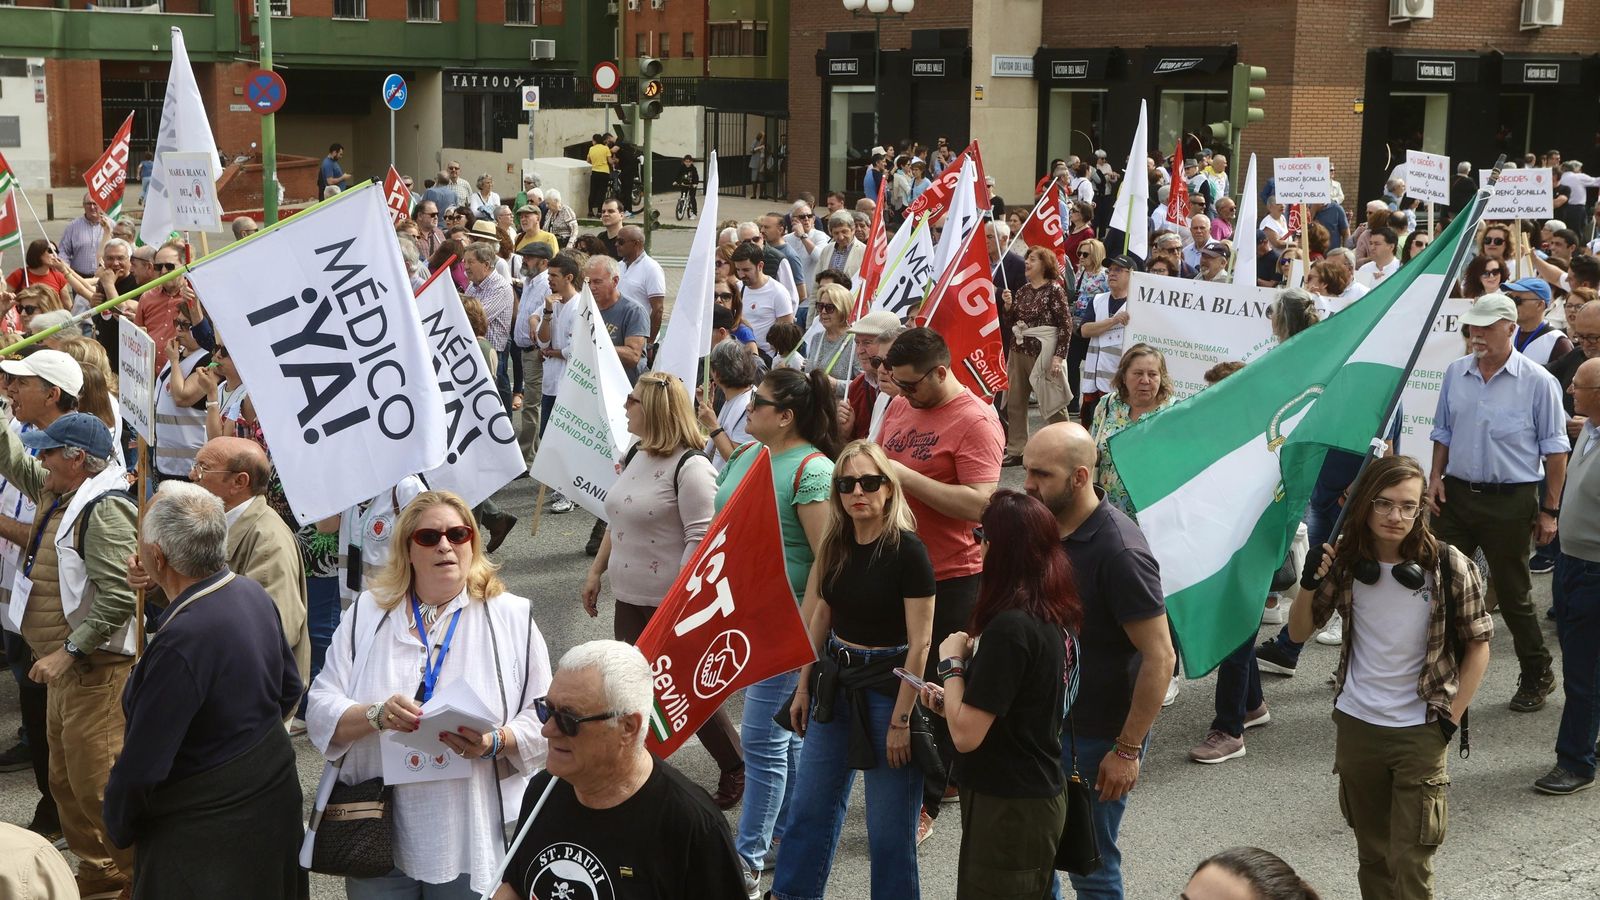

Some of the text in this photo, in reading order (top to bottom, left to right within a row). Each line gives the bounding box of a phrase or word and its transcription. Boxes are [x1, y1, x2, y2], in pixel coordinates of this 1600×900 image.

[452, 75, 510, 88] TATTOO
[168, 168, 207, 177] MAREA BLANCA
[1138, 286, 1209, 312] MAREA
[315, 237, 416, 441] MÉDICO
[1132, 333, 1229, 355] POR UNA ATENCIÓN PRIMARIA
[246, 287, 371, 445] ¡YA!
[573, 358, 591, 377] UNA
[1180, 350, 1190, 358] DE
[1190, 351, 1218, 363] CALIDAD
[422, 308, 517, 445] MÉDICO
[1407, 380, 1440, 391] FIENDE
[554, 417, 593, 447] SANIDAD
[650, 654, 690, 733] Sevilla
[539, 846, 606, 885] ST. PAULI
